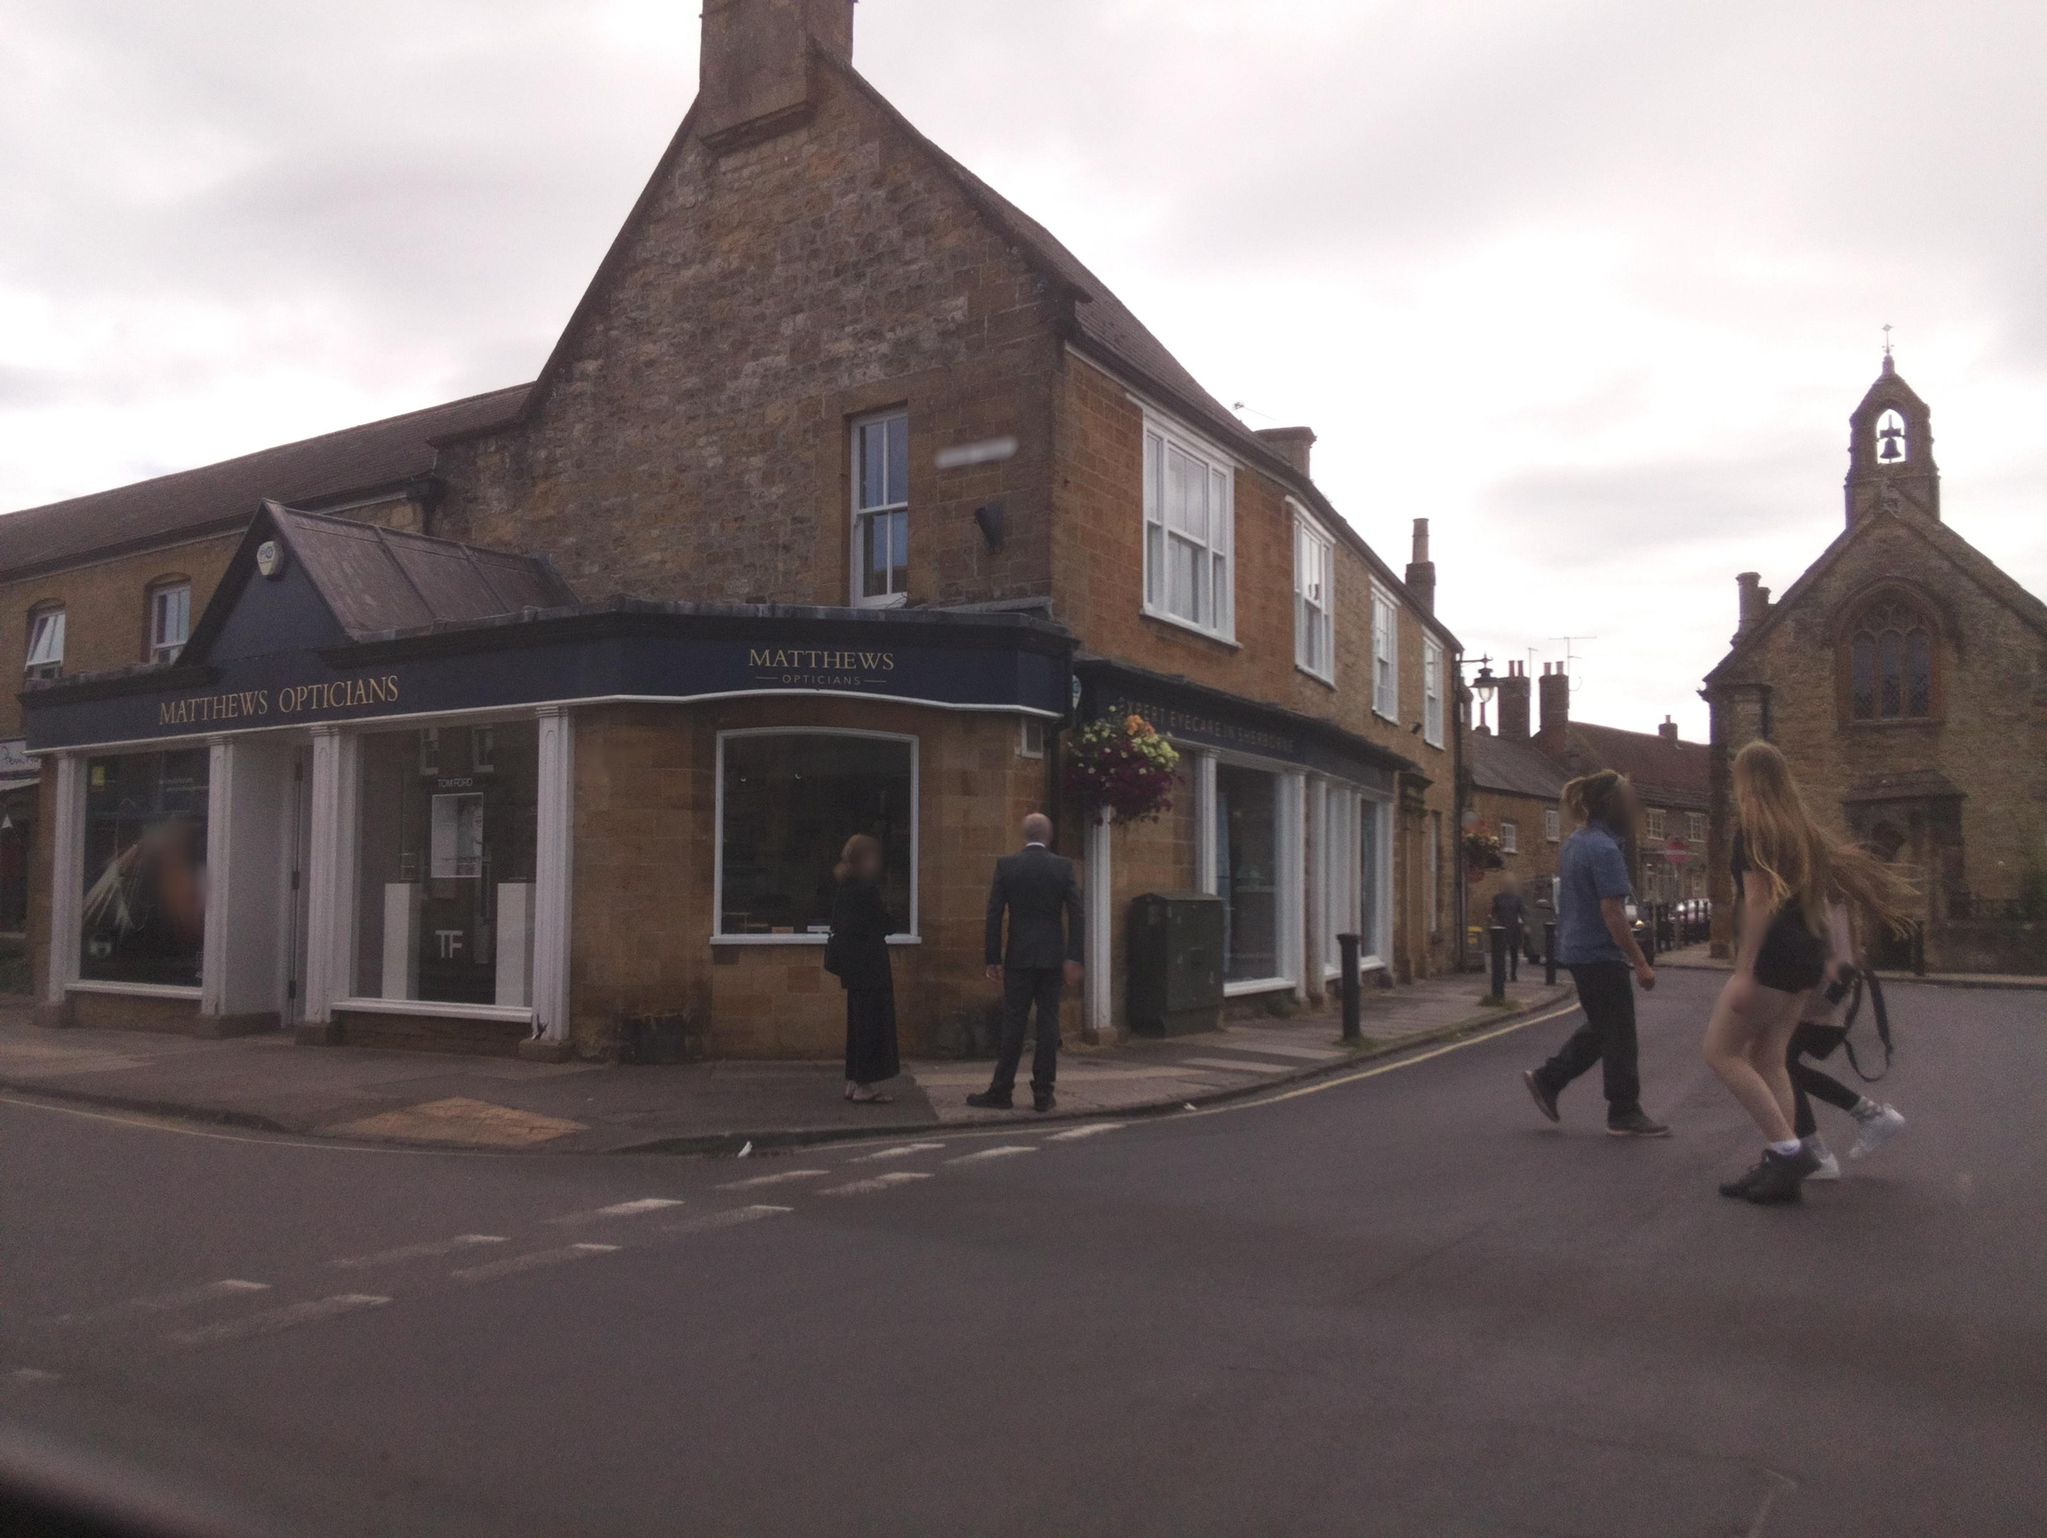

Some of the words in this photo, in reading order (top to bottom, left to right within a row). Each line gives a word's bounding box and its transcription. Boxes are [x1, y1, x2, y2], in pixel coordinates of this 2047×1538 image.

[749, 649, 895, 671] MATTHEWS
[782, 674, 861, 686] OPTICIANS
[159, 690, 268, 725] MATTHEWS
[278, 675, 399, 713] OPTICIANS
[435, 930, 464, 959] TF
